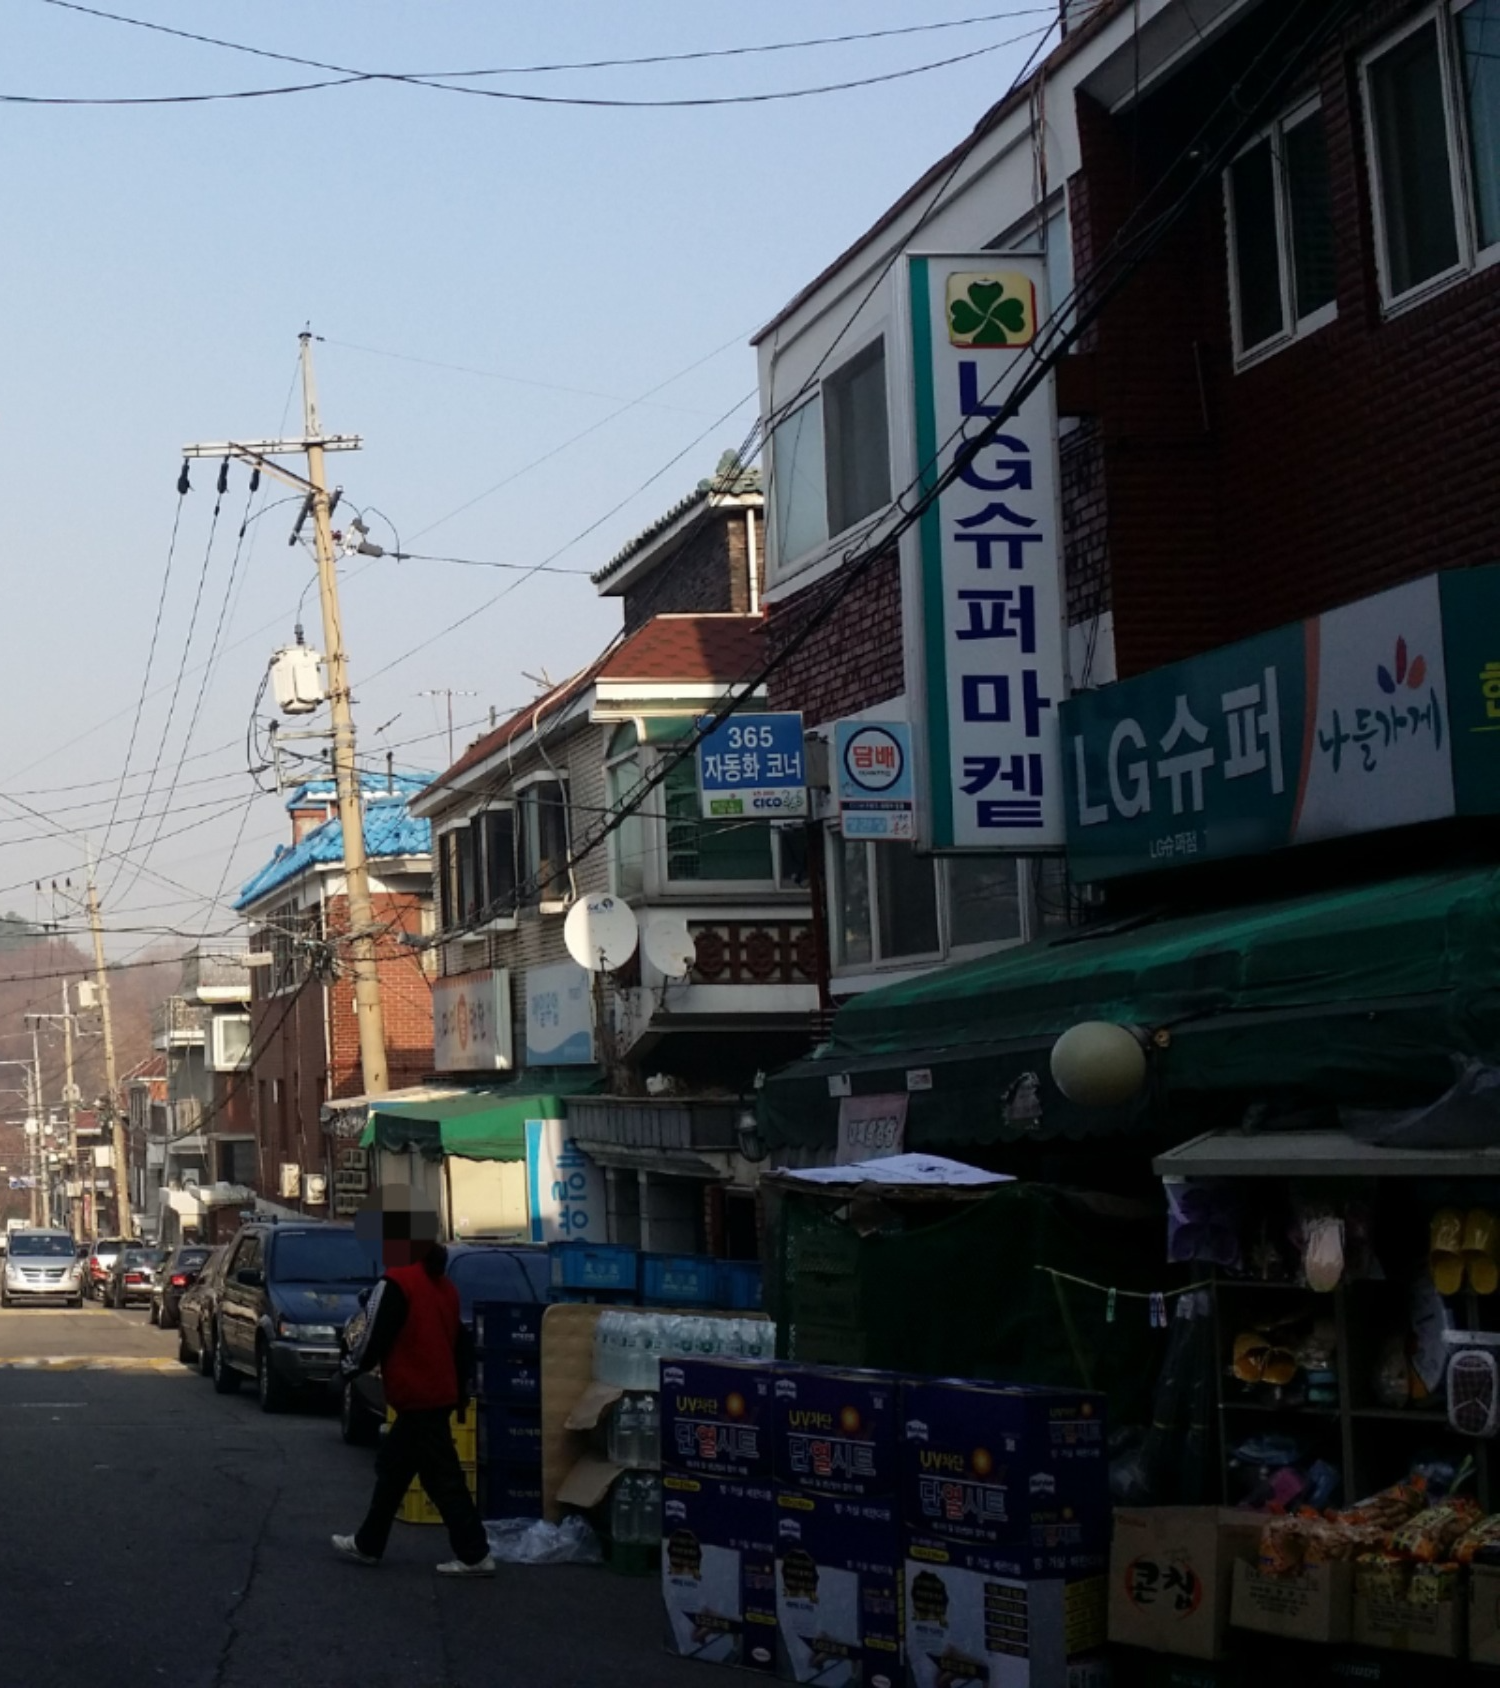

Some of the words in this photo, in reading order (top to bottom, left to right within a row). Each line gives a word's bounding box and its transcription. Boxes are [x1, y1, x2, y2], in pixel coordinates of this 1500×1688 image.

[727, 726, 774, 748] 365
[1073, 665, 1285, 827] LG슈퍼
[1318, 688, 1442, 774] 나들가게
[705, 753, 760, 783] 자동화
[766, 752, 802, 779] 코너
[852, 746, 895, 768] 담배
[789, 1437, 877, 1479] 단열시트
[919, 1480, 1009, 1524] 단열시트
